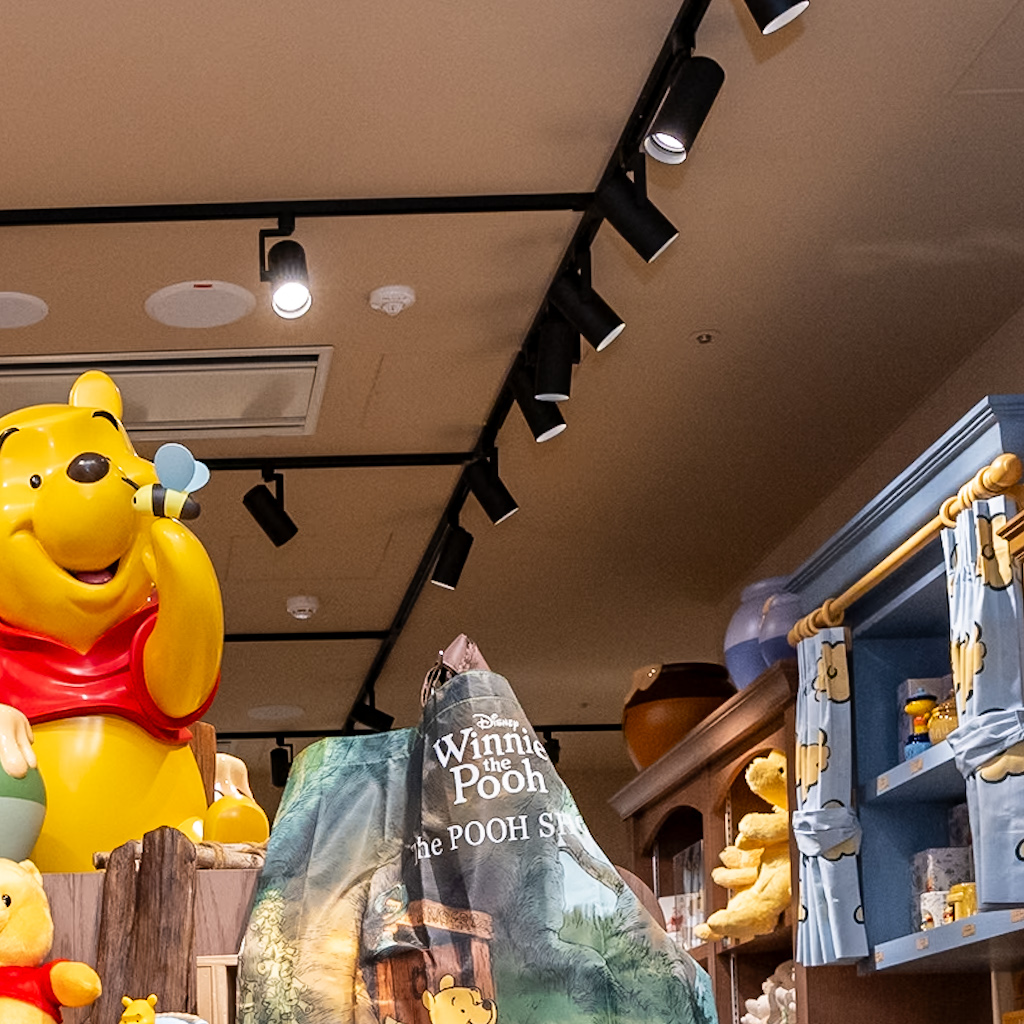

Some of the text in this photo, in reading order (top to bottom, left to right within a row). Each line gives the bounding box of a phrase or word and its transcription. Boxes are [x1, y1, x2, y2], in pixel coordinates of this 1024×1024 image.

[473, 713, 519, 730] Disney
[433, 727, 548, 768] Winnie
[483, 757, 511, 772] the
[450, 758, 549, 805] Pooh
[447, 815, 530, 850] POOH
